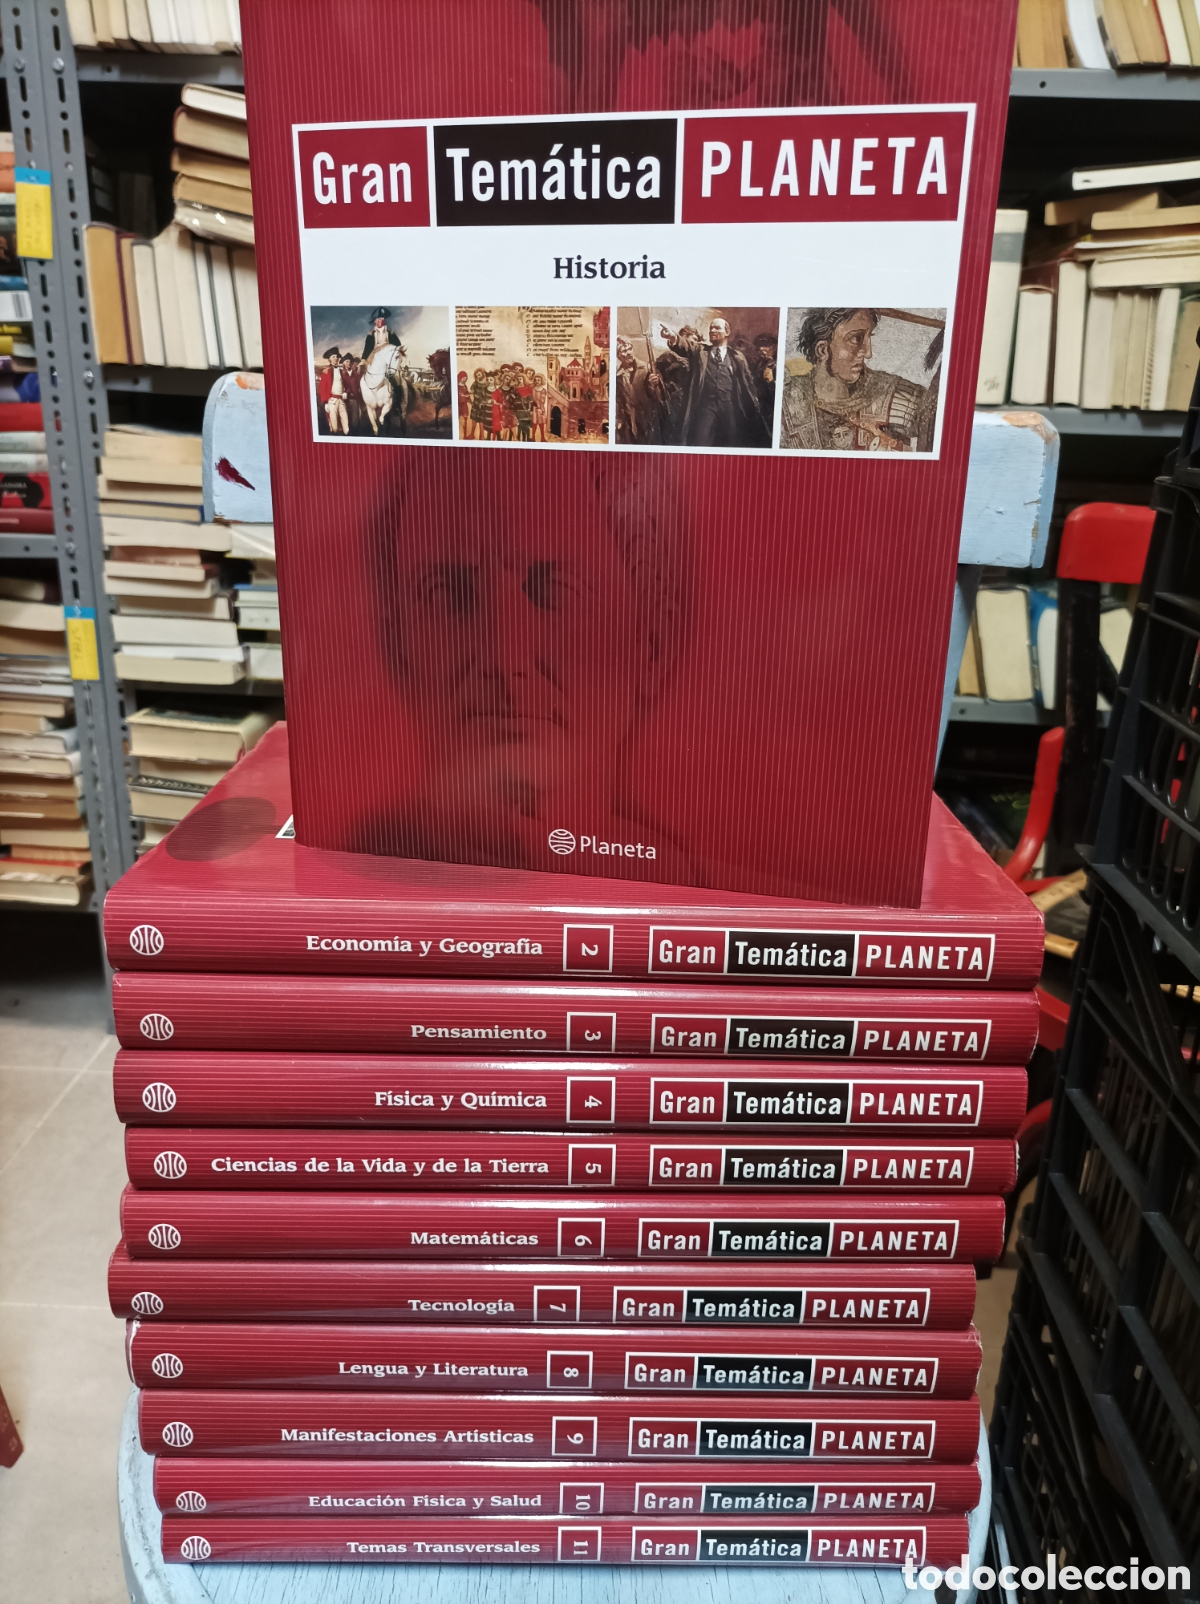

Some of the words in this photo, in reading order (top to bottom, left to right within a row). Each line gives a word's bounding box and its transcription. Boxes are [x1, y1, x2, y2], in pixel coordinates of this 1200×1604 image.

[312, 151, 412, 205] Gran
[445, 143, 661, 202] Temática
[701, 136, 948, 198] PLANETA
[552, 253, 668, 282] Historia
[580, 835, 656, 860] Planeta
[305, 935, 413, 952] Economía
[418, 940, 433, 957] y
[439, 937, 543, 959] Geografía
[581, 942, 599, 957] 2
[659, 939, 716, 964] Gran
[734, 941, 847, 968] Temática
[865, 944, 983, 971] PLANETA
[410, 1024, 547, 1040] Pensamiento
[584, 1029, 602, 1042] 3
[661, 1025, 717, 1047] Gran
[735, 1027, 846, 1050] Temática
[863, 1029, 978, 1052] PLANETA
[374, 1090, 435, 1107] Física
[440, 1095, 454, 1111] y
[460, 1091, 547, 1110] Química
[584, 1095, 603, 1109] 4
[660, 1090, 715, 1114] Gran
[733, 1091, 842, 1115] Temática
[859, 1092, 972, 1116] PLANETA
[211, 1156, 298, 1172] Ciencias
[304, 1157, 330, 1173] de
[335, 1157, 355, 1173] la
[361, 1157, 407, 1173] Vida
[413, 1161, 426, 1177] y
[432, 1157, 457, 1173] de
[463, 1157, 483, 1173] la
[488, 1158, 549, 1173] Tierra
[585, 1162, 602, 1174] 5
[659, 1156, 713, 1178] Gran
[730, 1157, 836, 1179] Temática
[853, 1158, 962, 1179] PLANETA
[410, 1231, 539, 1245] Matemáticas
[574, 1234, 593, 1247] 6
[647, 1229, 701, 1250] Gran
[718, 1229, 823, 1251] Temática
[839, 1230, 947, 1251] PLANETA
[407, 1298, 515, 1315] Tecnología
[549, 1303, 567, 1313] 7
[622, 1297, 675, 1317] Gran
[692, 1297, 795, 1318] Temática
[812, 1298, 919, 1319] PLANETA
[338, 1361, 409, 1378] Lengua
[414, 1365, 427, 1379] y
[433, 1362, 529, 1377] Literatura
[563, 1367, 579, 1378] 8
[634, 1363, 686, 1383] Gran
[703, 1364, 805, 1385] Temática
[821, 1366, 927, 1386] PLANETA
[281, 1427, 437, 1443] Manifestaciones
[443, 1429, 534, 1443] Artísticas
[566, 1432, 584, 1445] 9
[638, 1428, 689, 1449] Gran
[705, 1429, 805, 1450] Temática
[821, 1430, 925, 1450] PLANETA
[308, 1494, 406, 1507] Educación
[412, 1494, 467, 1507] Física
[472, 1497, 484, 1510] y
[490, 1494, 542, 1507] Salud
[575, 1494, 591, 1511] 10
[643, 1492, 694, 1509] Gran
[710, 1492, 808, 1509] Temática
[823, 1492, 924, 1509] PLANETA
[346, 1541, 408, 1553] Temas
[412, 1540, 541, 1553] Transversales
[573, 1540, 589, 1555] 11
[640, 1538, 690, 1556] Gran
[705, 1537, 802, 1557] Temática
[817, 1538, 918, 1558] PLANETA
